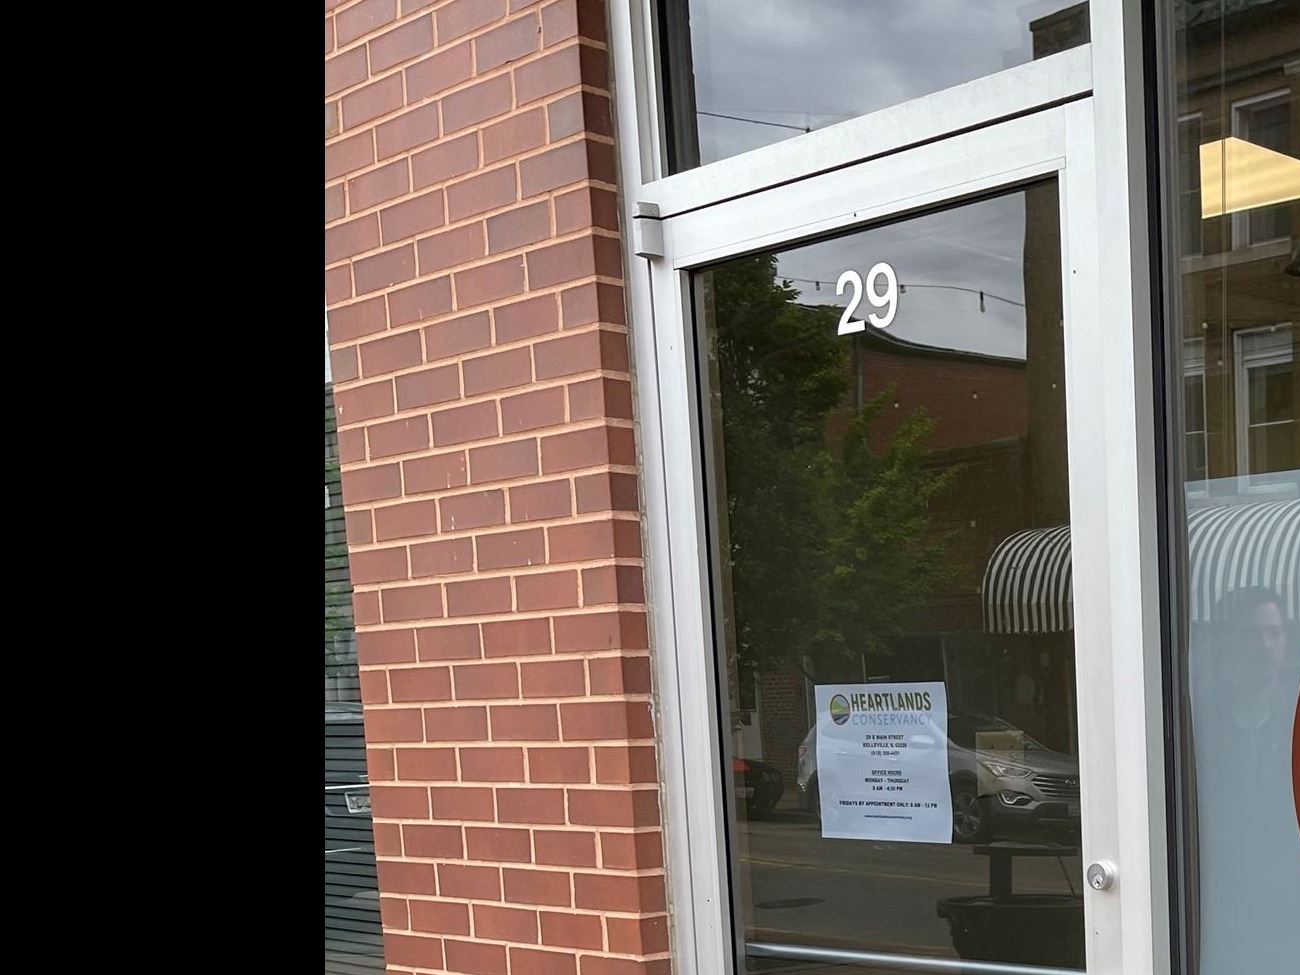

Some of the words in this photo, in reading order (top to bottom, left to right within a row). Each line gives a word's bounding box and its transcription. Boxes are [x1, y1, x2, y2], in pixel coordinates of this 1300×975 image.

[836, 262, 898, 336] 29
[850, 691, 932, 712] HEARTLANDS
[851, 713, 932, 726] CONSERVANCY
